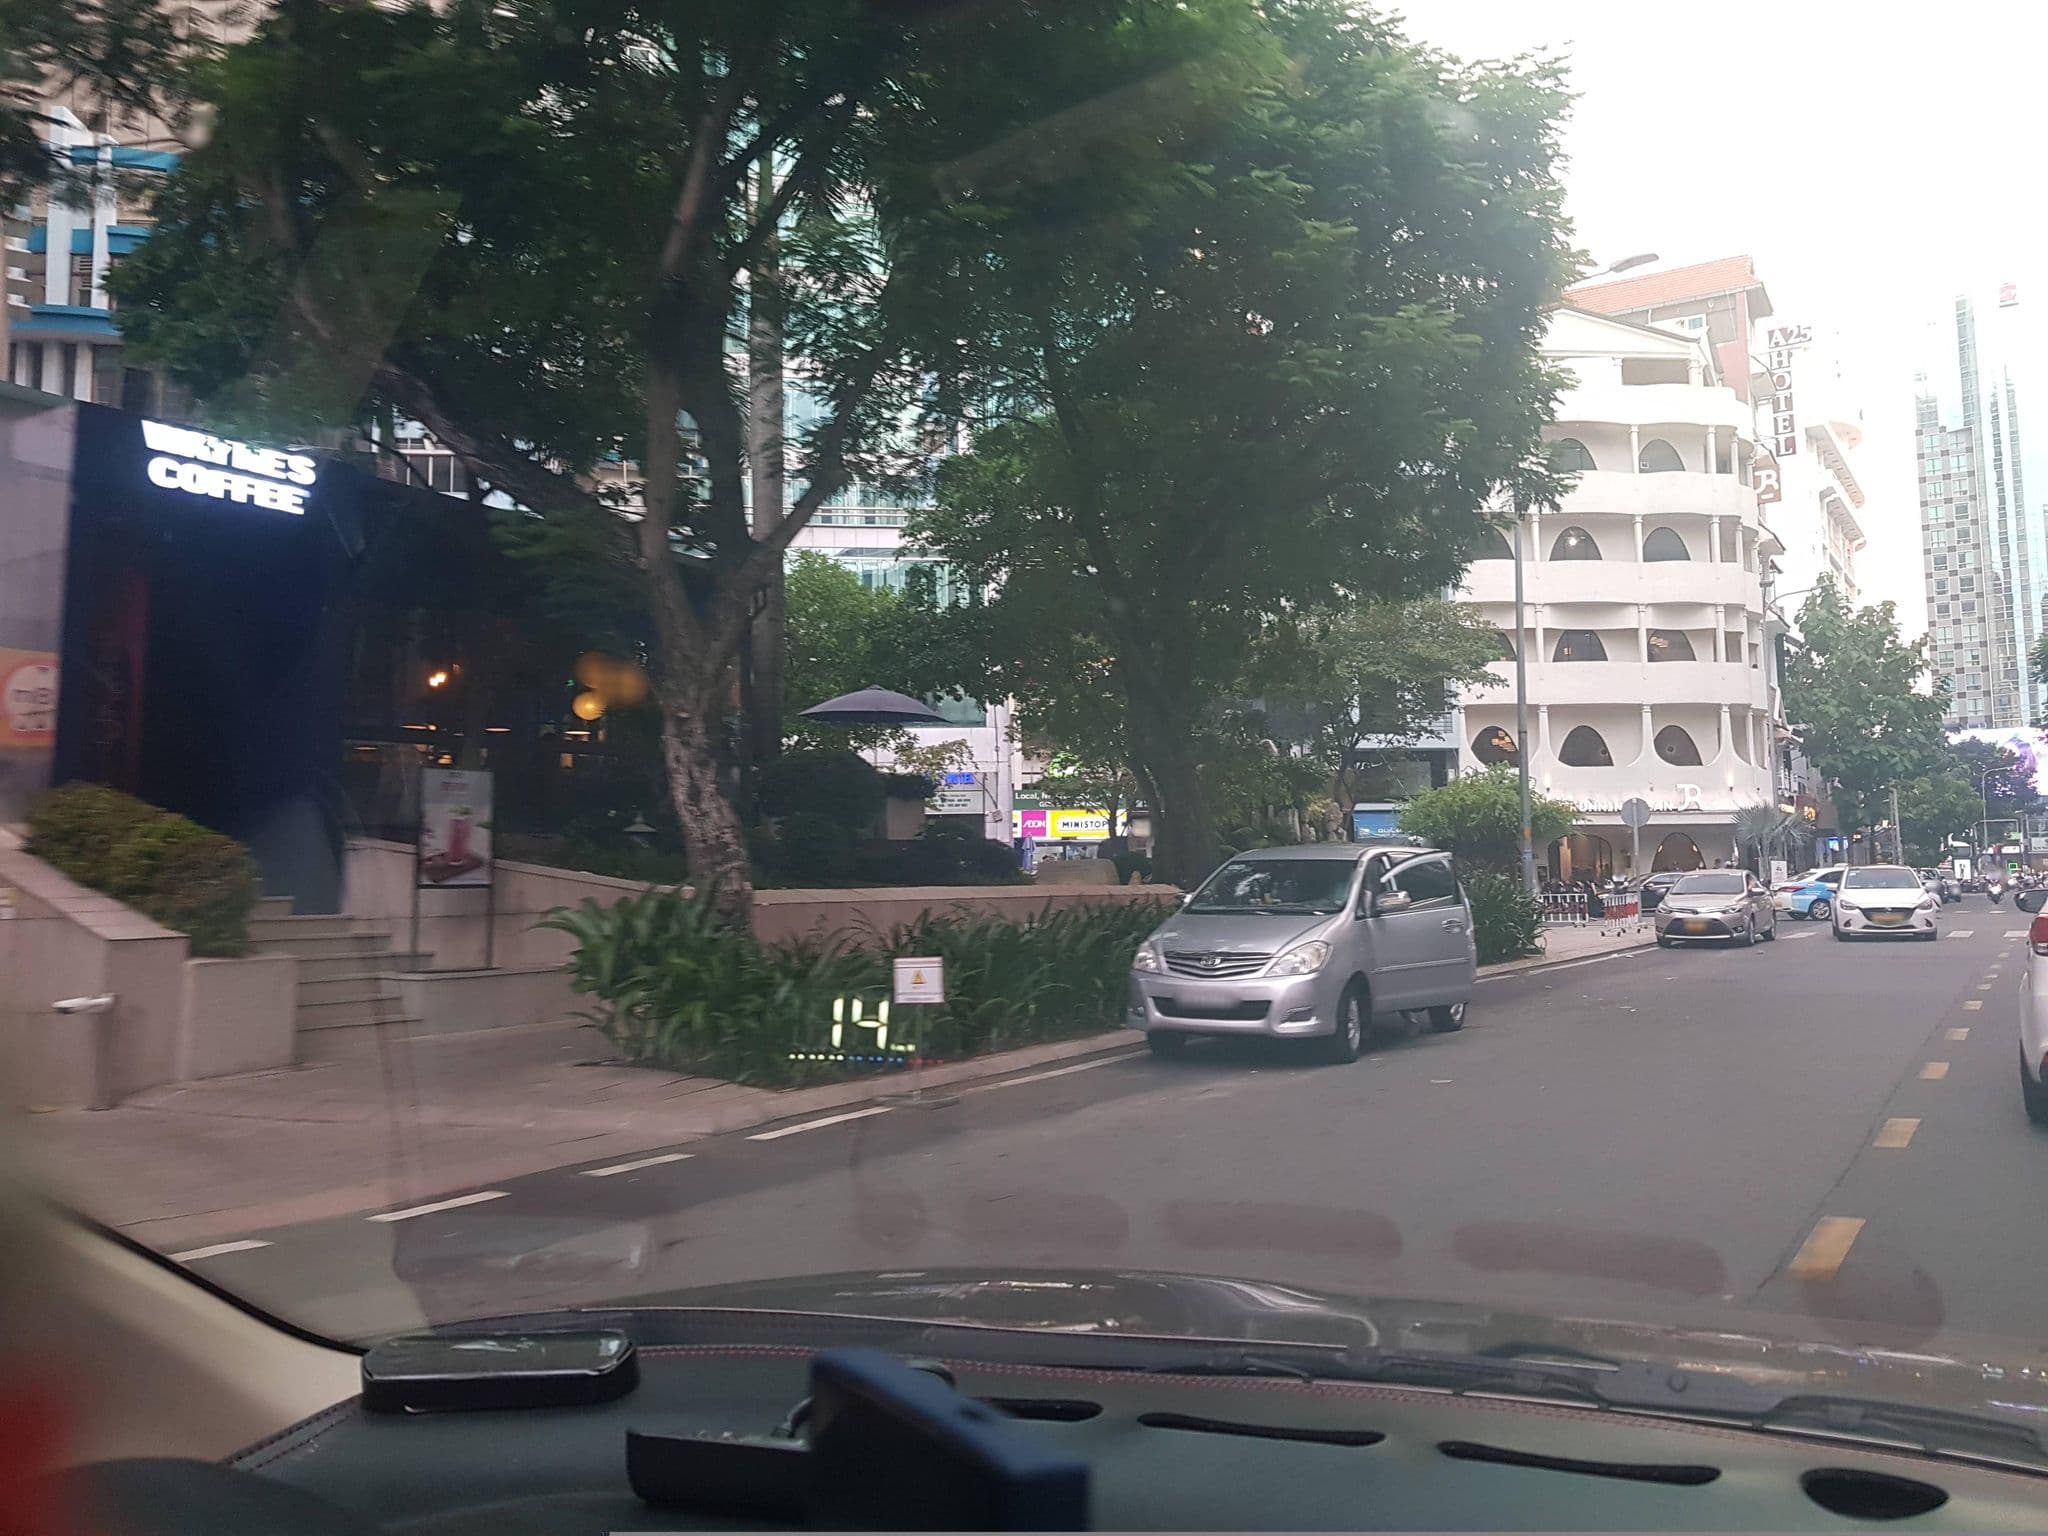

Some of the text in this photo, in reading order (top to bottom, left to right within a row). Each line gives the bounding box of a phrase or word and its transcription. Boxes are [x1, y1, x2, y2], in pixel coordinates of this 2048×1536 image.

[1769, 325, 1812, 348] A25
[1770, 351, 1796, 457] HOTEL
[147, 456, 312, 515] COFFEE
[1062, 820, 1109, 829] MINISTOP
[832, 998, 889, 1049] 14
